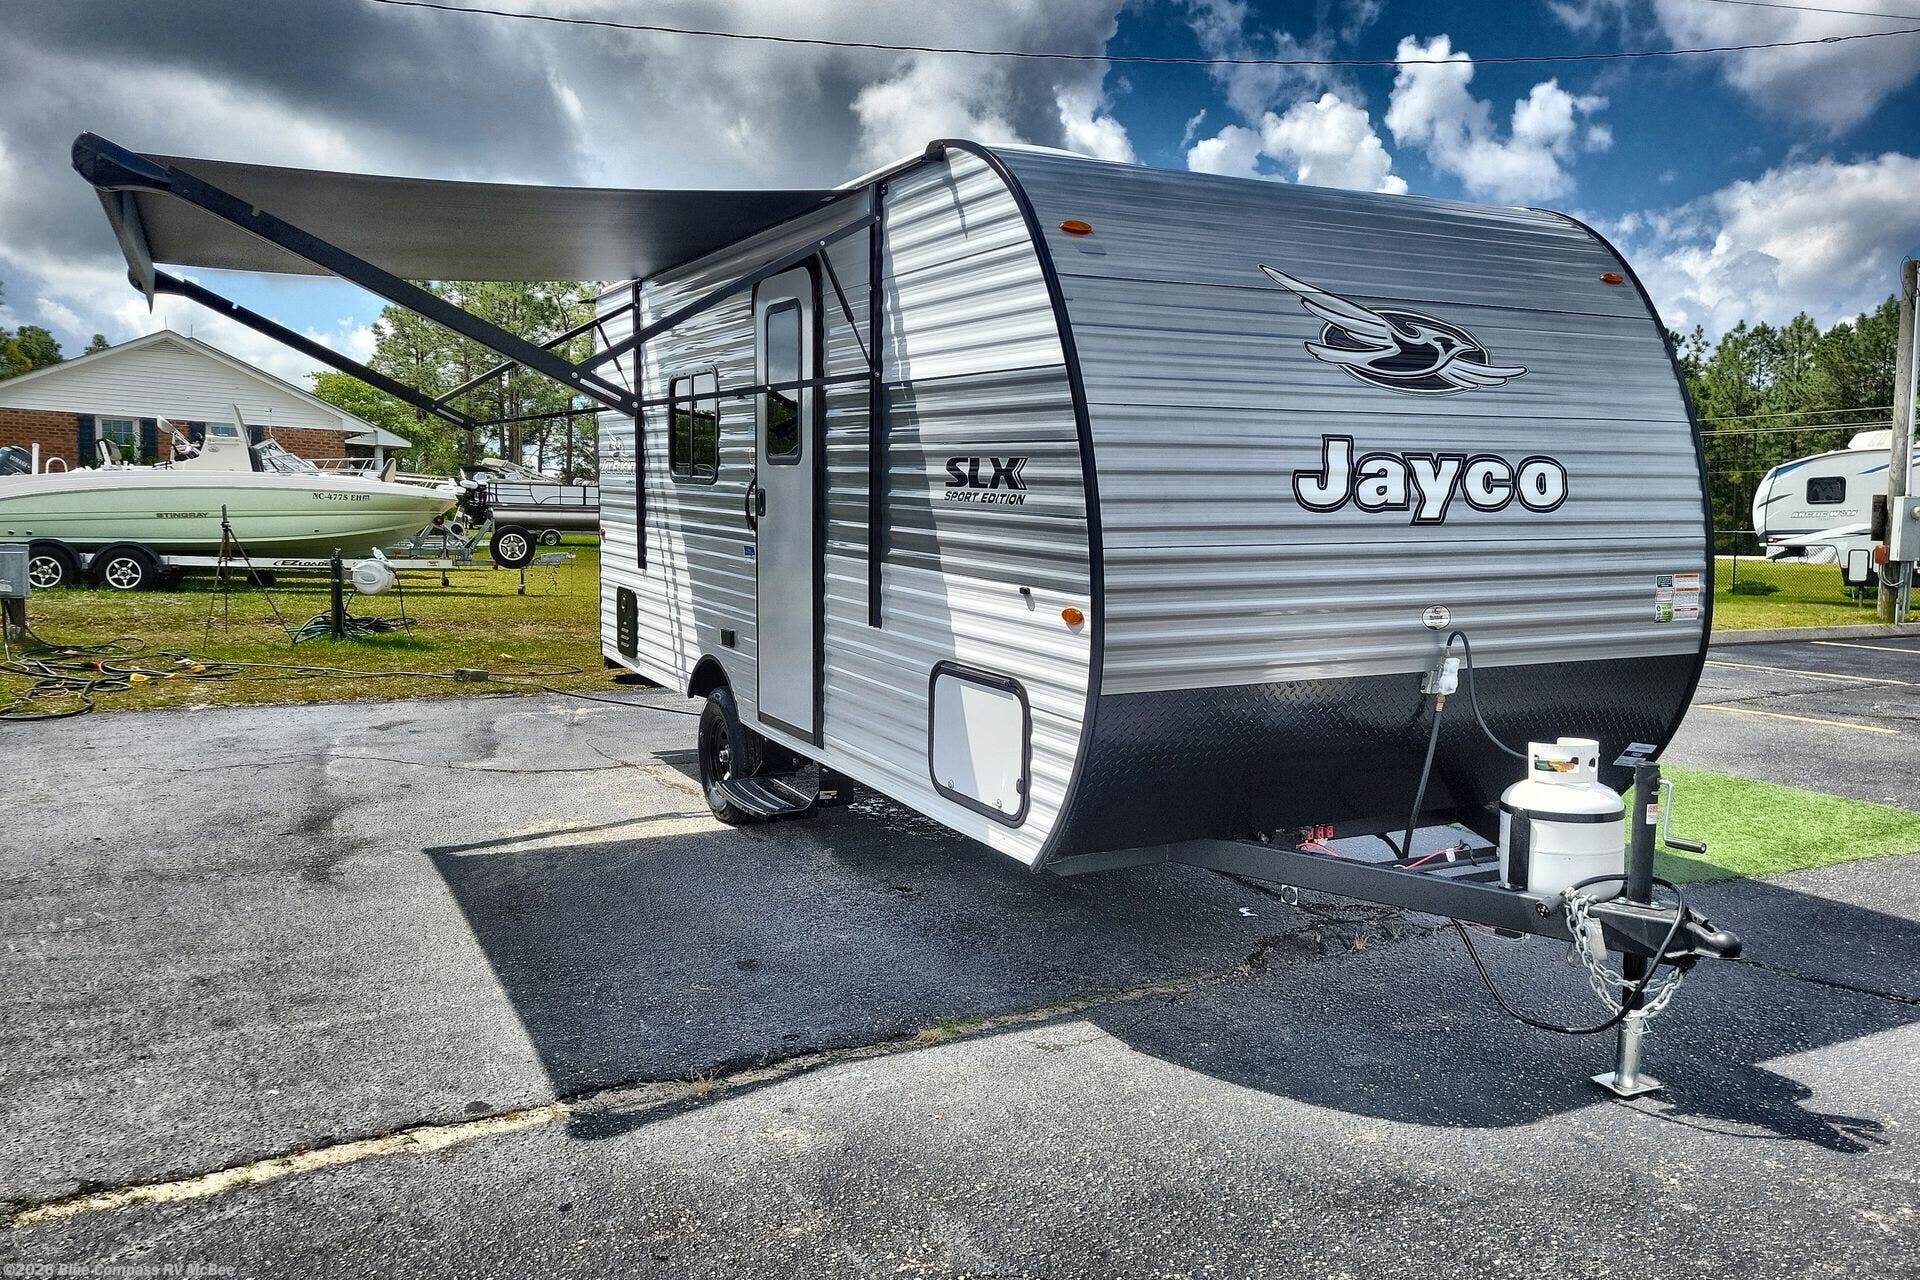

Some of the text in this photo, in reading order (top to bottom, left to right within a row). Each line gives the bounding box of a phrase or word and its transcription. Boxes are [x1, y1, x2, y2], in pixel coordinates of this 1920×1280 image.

[945, 457, 1029, 490] SLX
[1292, 434, 1568, 526] Jayco
[944, 490, 1026, 506] SPORT EDITION
